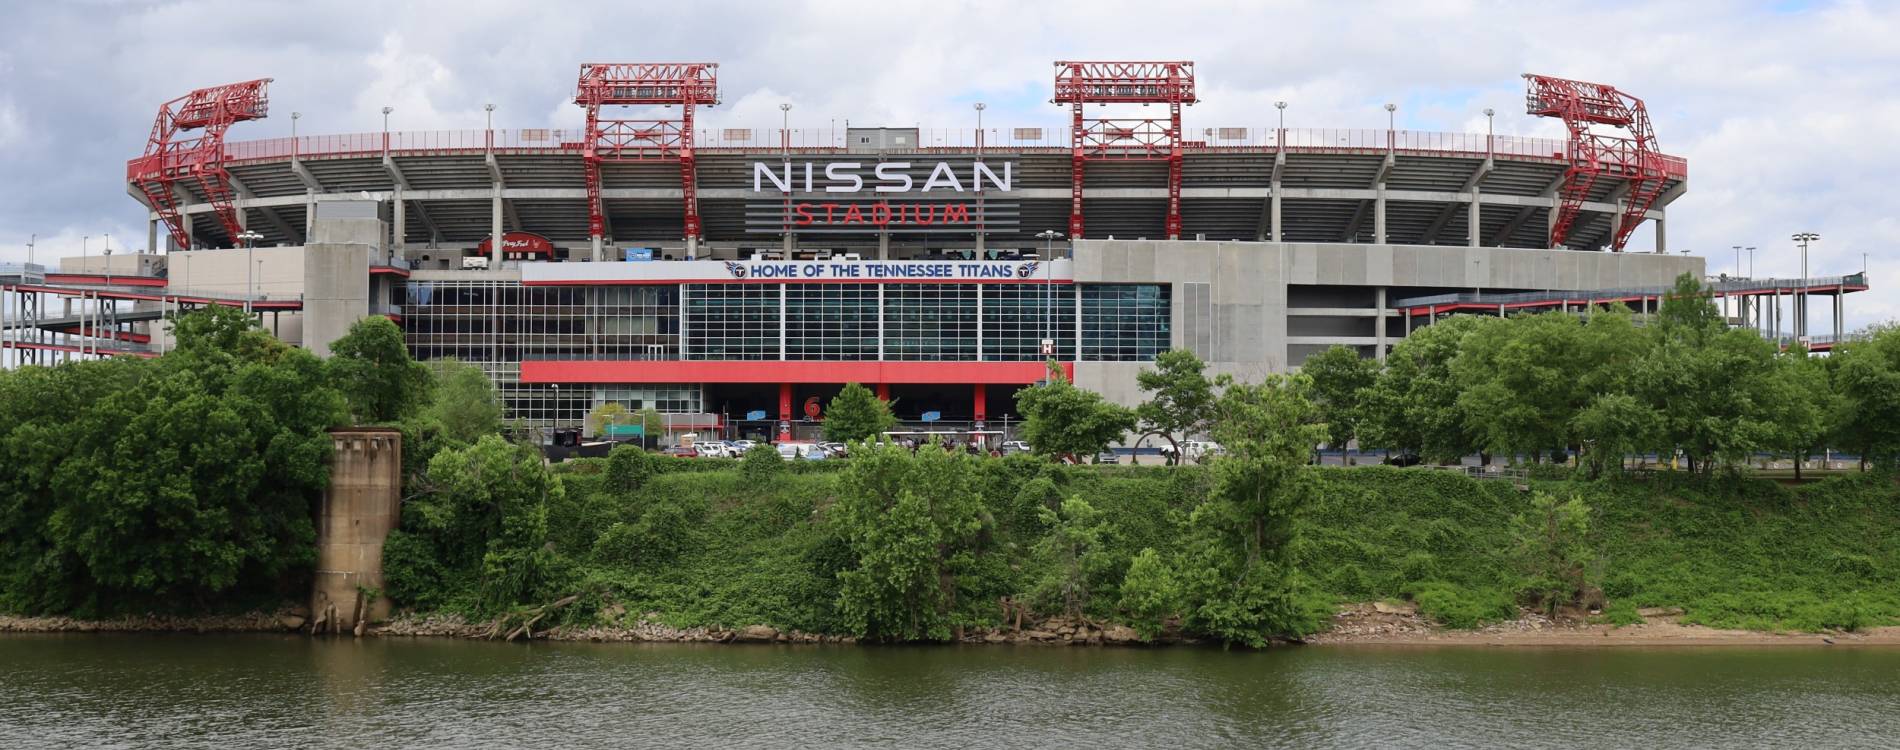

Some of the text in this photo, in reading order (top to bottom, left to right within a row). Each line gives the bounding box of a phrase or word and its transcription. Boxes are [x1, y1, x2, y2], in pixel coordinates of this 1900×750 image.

[753, 161, 1012, 193] NISSAN
[795, 203, 969, 225] STADIUM
[751, 264, 1013, 278] HOME OF THE TENNESSEE TITANS
[1043, 344, 1052, 354] H
[804, 395, 821, 417] 6
